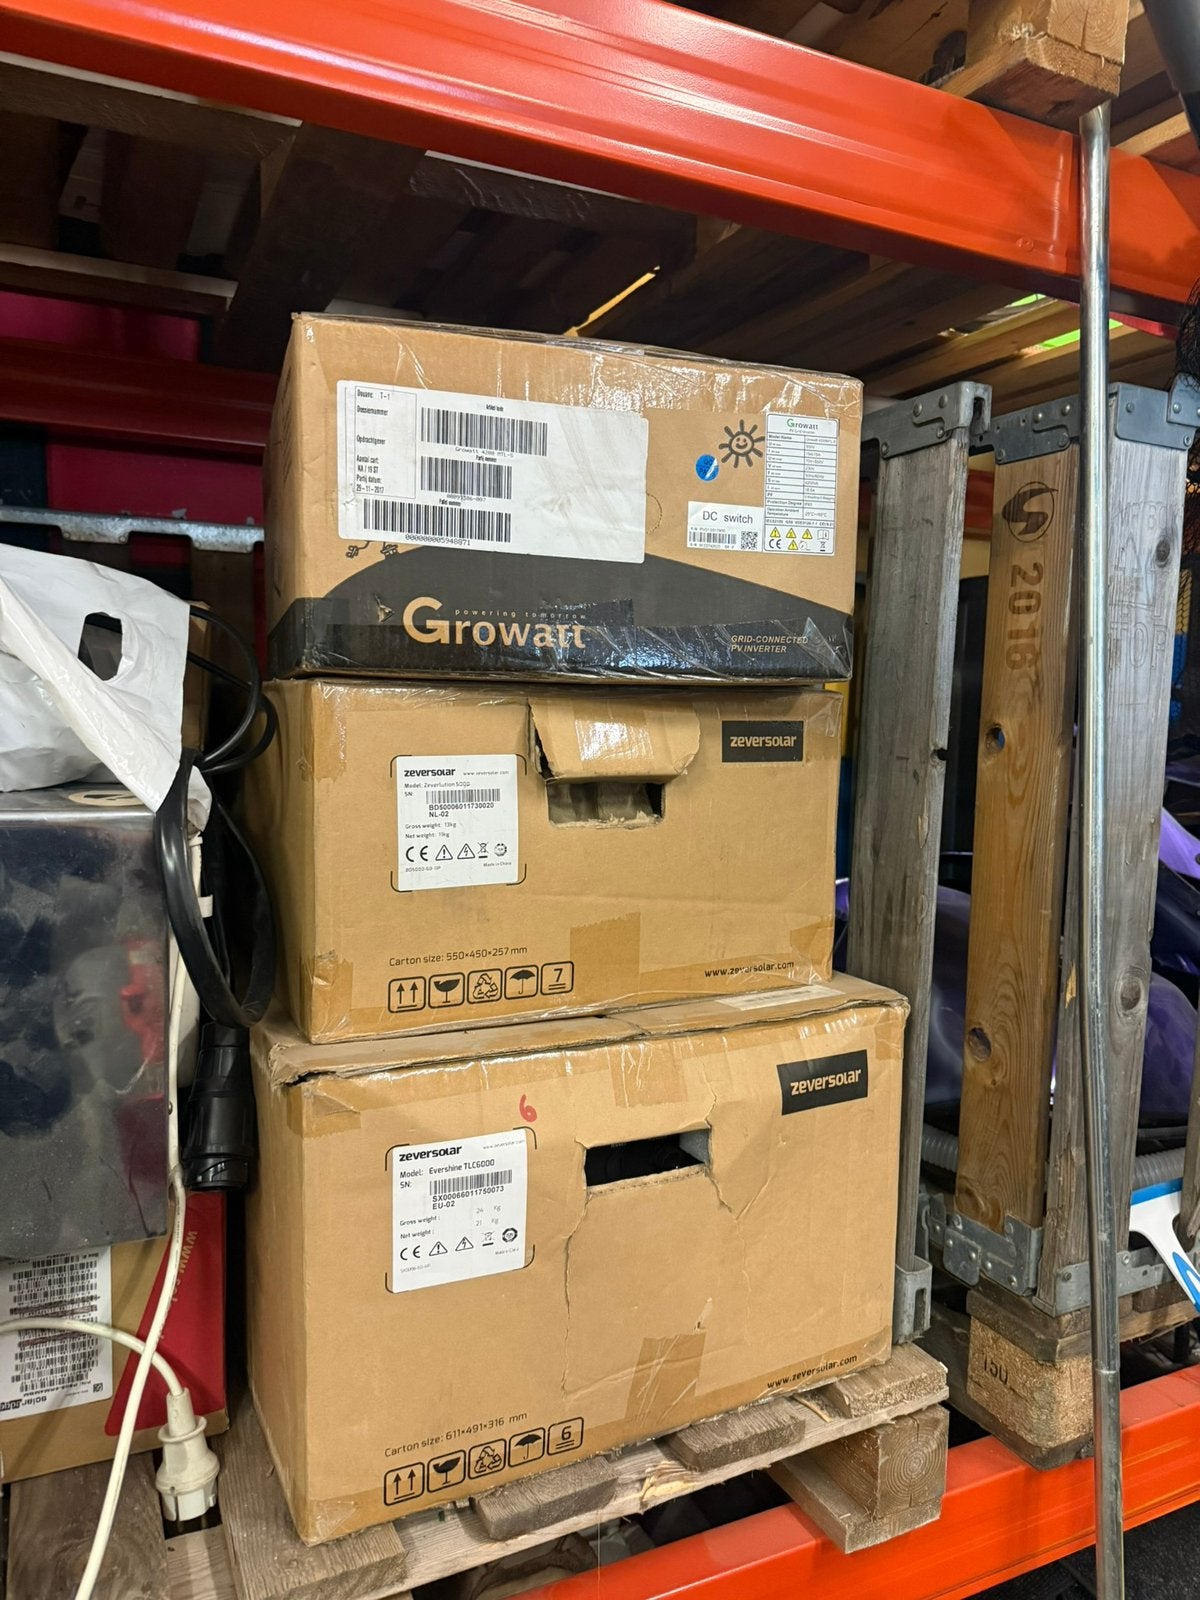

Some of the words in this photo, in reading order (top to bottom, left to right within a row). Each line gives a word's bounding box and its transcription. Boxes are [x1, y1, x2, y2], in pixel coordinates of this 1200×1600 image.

[787, 419, 819, 430] Growatt
[702, 511, 718, 521] DC
[723, 513, 753, 524] switch
[455, 609, 516, 618] powering
[525, 611, 587, 619] tomorrow
[403, 597, 586, 649] Growatt
[731, 635, 809, 644] GRID-CONNECTED
[744, 645, 787, 653] INVERTER
[730, 735, 797, 747] zeversolar
[404, 768, 456, 777] zeversolar
[389, 957, 421, 966] Carton
[423, 953, 444, 964] size:
[510, 946, 527, 955] mm
[554, 968, 563, 983] 7
[790, 1068, 862, 1096] zeversolar
[519, 1094, 538, 1123] 6
[399, 1145, 462, 1162] zeversolar
[400, 1168, 424, 1179] Model:
[429, 1164, 462, 1175] Evershine
[464, 1158, 495, 1170] TLC6000
[400, 1181, 412, 1189] SN:
[432, 1200, 455, 1210] EU-02
[400, 1218, 417, 1226] Gross
[400, 1231, 411, 1239] Net
[767, 1354, 858, 1389] www.zeversolar.com
[384, 1441, 419, 1457] Carton
[421, 1433, 445, 1447] size:
[508, 1412, 528, 1424] mm
[561, 1425, 572, 1441] 6
